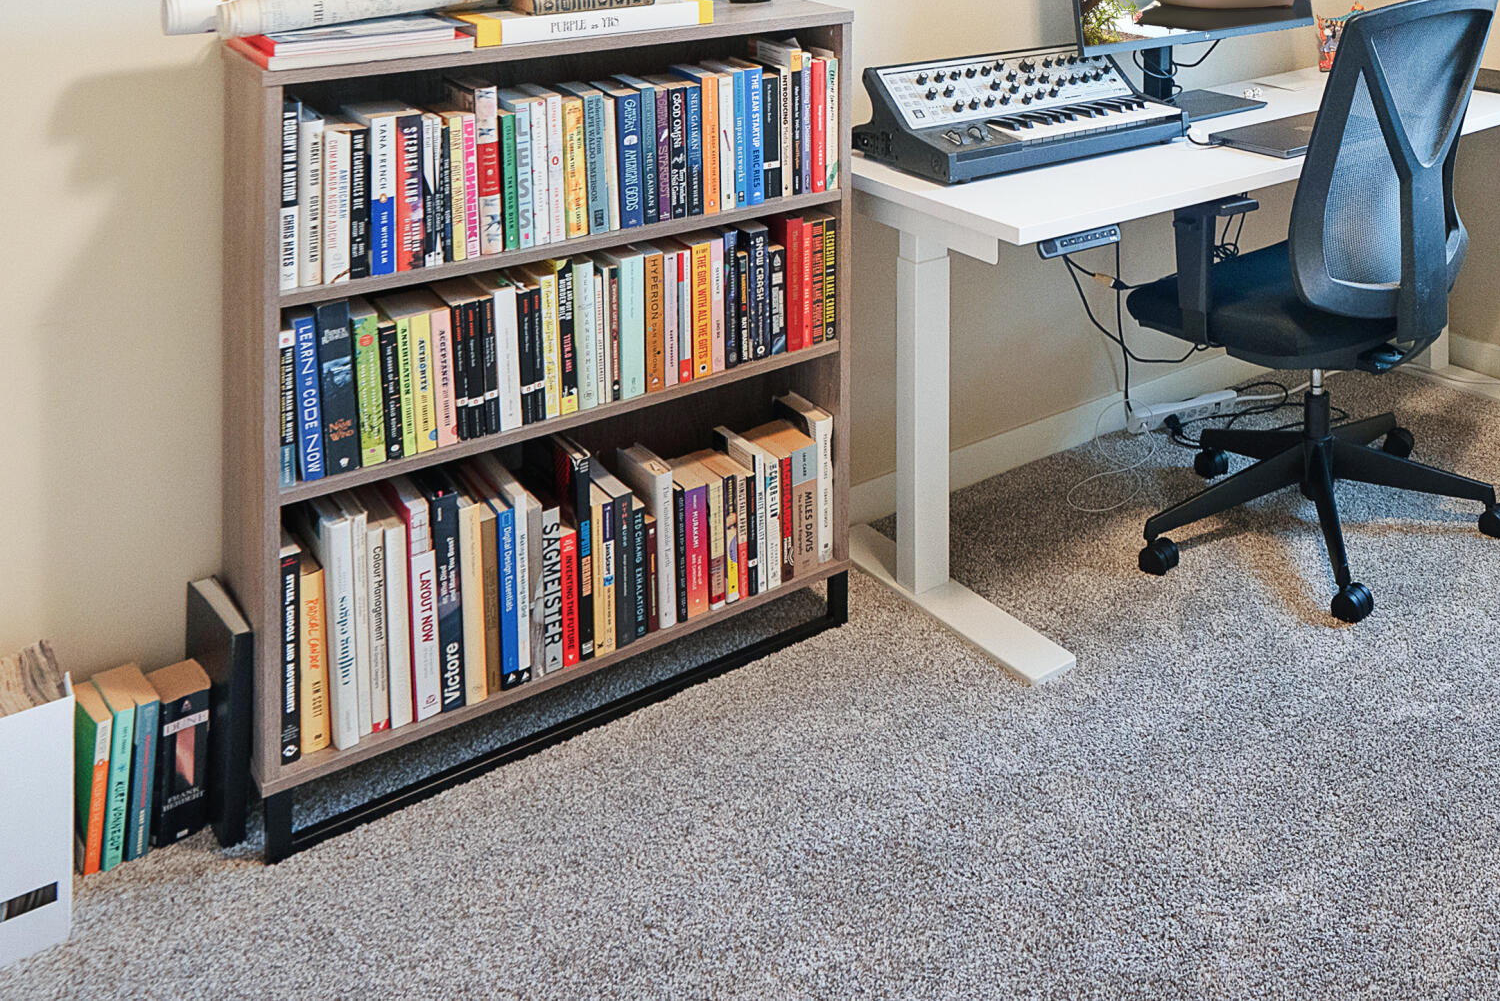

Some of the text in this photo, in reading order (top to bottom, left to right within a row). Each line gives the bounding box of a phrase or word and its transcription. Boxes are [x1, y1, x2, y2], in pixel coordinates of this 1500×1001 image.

[551, 19, 586, 33] PURPLE
[602, 16, 619, 28] YRS
[751, 73, 759, 89] THE
[283, 119, 297, 150] COLONY
[353, 135, 364, 149] HOW
[670, 93, 682, 148] GOOD OMENS
[690, 93, 699, 149] NEIL GAIMAN
[752, 113, 760, 147] STARTUP
[283, 154, 296, 162] IN
[310, 142, 319, 186] NICKEL BOYS
[353, 151, 364, 197] DEMOCRACIES
[379, 125, 387, 189] TANA FRENCH
[403, 127, 418, 203] STEPHEN KING
[464, 123, 477, 239] PALAHNIUK
[589, 161, 597, 202] EMERSON
[624, 149, 638, 211] AMERICAN GODS
[658, 145, 670, 198] STARDUST
[283, 172, 296, 201] NATION
[328, 140, 337, 249] CHIMAMANDA NGOZI ADICHIE
[339, 170, 348, 219] AMERICANAH
[353, 199, 363, 210] DIE
[283, 215, 295, 267] CHRIS HAYES
[309, 196, 319, 263] COLSON WHITEHEAD
[380, 212, 388, 224] THE
[755, 236, 764, 266] SNOW
[826, 231, 835, 323] RECURSION BLAKE CROUCH
[650, 258, 659, 320] HYPERION
[697, 255, 709, 359] THE GIRL WITH ALL THE GIFTS
[756, 268, 764, 300] CRASH
[285, 348, 293, 361] THIS
[285, 373, 293, 388] YOUR
[401, 328, 410, 396] ANNIHILATION
[418, 339, 427, 392] AUTHORITY
[439, 330, 448, 388] ACCEPTANCE
[285, 390, 293, 409] BRAIN
[286, 411, 293, 420] ON
[299, 325, 321, 473] LEARN TO CODE NOW
[286, 423, 294, 443] MUSIC
[737, 479, 746, 498] THINGS
[738, 501, 746, 514] FALL
[518, 535, 526, 555] Making
[663, 501, 671, 546] Uninhabitable
[738, 515, 747, 536] APART
[804, 491, 814, 552] MILES DAVIS
[503, 527, 513, 612] Digital Design Essentials
[634, 512, 644, 621] TED CHIANG EXHALATION
[664, 548, 672, 568] Earth
[372, 546, 384, 641] Colour Management
[419, 569, 434, 643] LAYOUT NOW
[542, 523, 562, 648] SAGMEISTER
[565, 555, 575, 650] INVENTING THE FUTURE
[284, 574, 297, 714] STYLES, SCHOOLS AND MOVEMENTS
[305, 599, 323, 718] RADICAL CANDOR KIM SCOTT
[444, 642, 460, 705] Victore
[109, 781, 125, 851] KURT VONNEGUT
